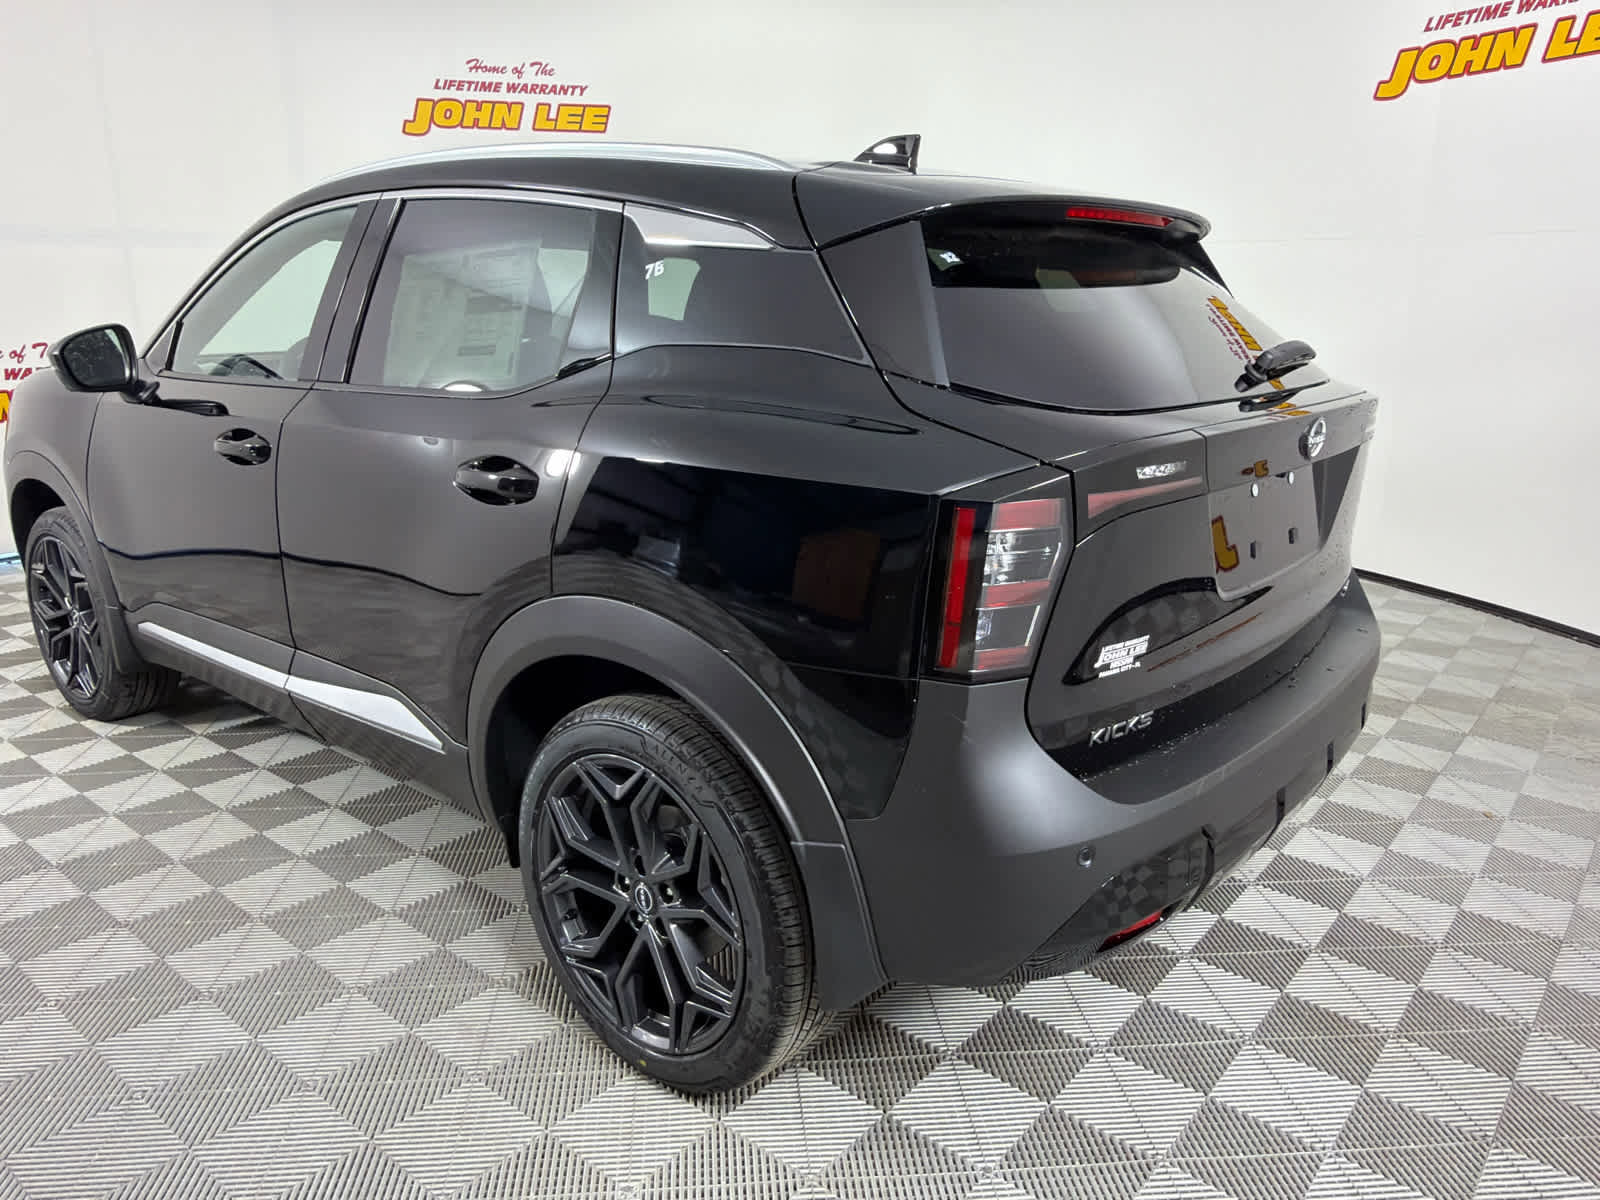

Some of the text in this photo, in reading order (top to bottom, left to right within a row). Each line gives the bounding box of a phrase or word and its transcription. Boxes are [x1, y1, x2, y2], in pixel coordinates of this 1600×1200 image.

[1423, 0, 1513, 32] LIFETIME
[465, 58, 555, 79] Home of The
[1373, 23, 1539, 101] JOHN
[433, 78, 588, 97] LIFETIME WARRANTY
[402, 98, 611, 136] JOHN LEE
[1089, 710, 1154, 748] KICKS
